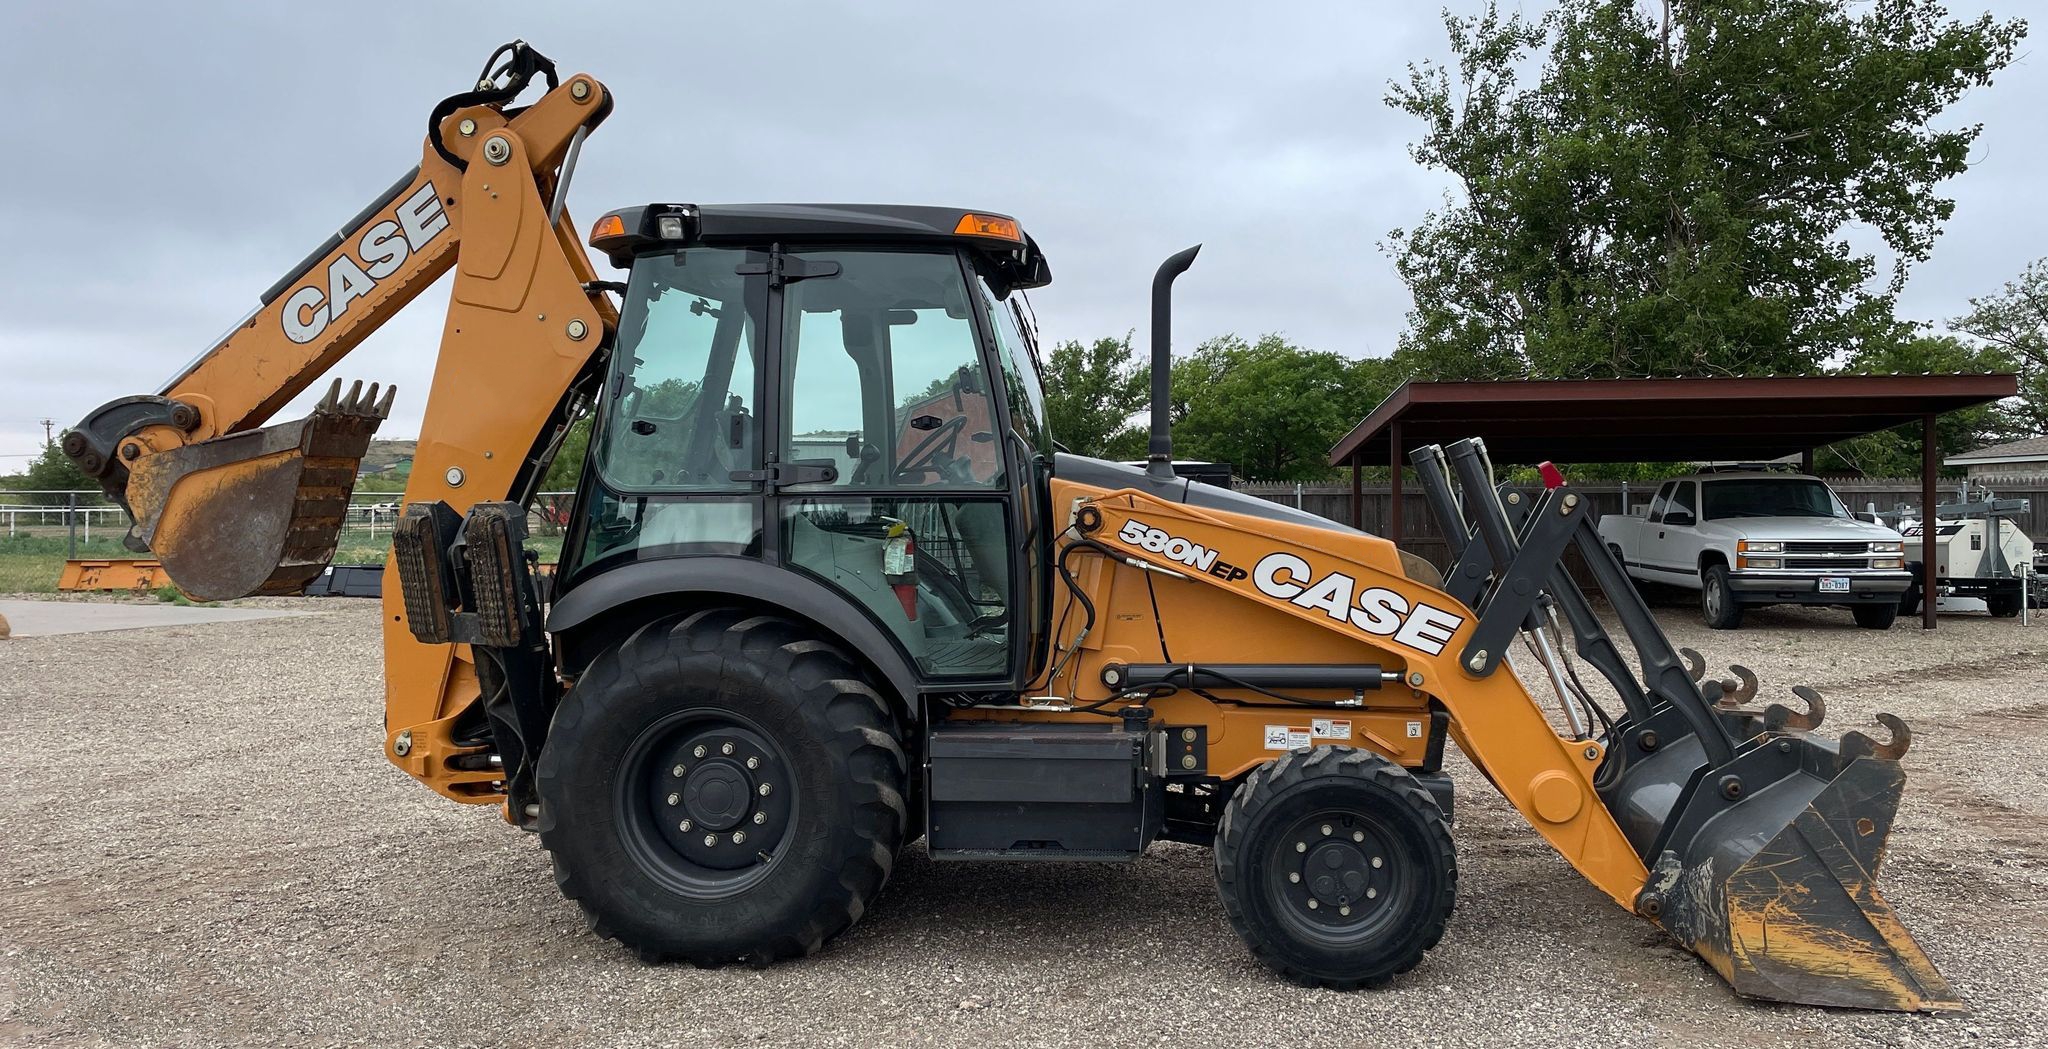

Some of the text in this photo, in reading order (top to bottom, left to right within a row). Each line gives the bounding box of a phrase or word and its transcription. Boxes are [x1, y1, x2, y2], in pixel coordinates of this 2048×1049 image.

[281, 180, 450, 344] CASE
[1118, 519, 1248, 583] 580N EP
[1253, 552, 1464, 656] CASE
